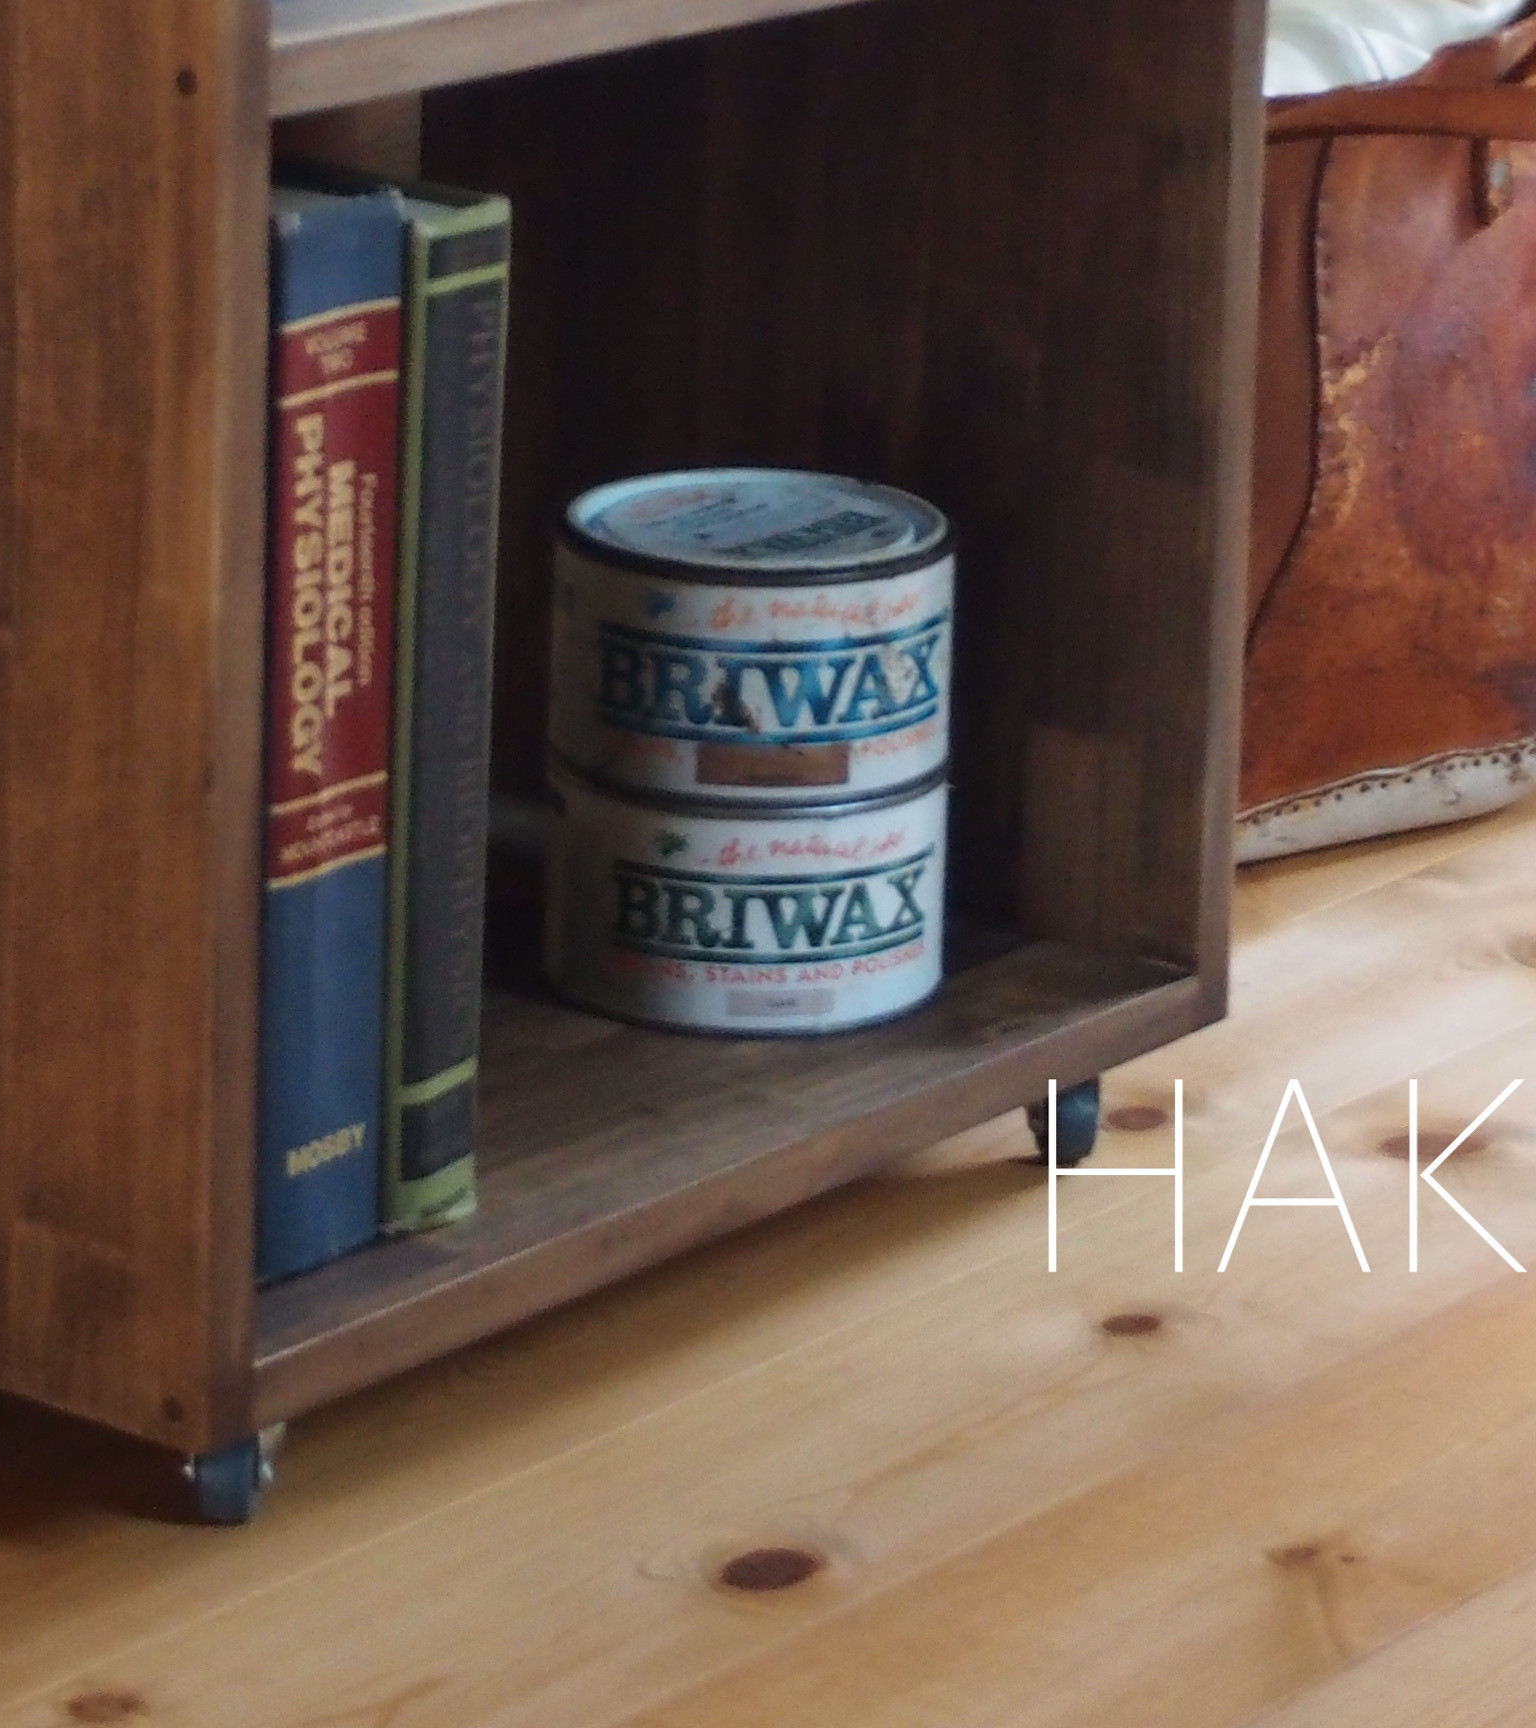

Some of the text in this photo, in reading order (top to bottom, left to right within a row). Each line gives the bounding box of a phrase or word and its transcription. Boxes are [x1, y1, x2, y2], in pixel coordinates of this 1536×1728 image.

[289, 412, 325, 776] PHYSIOLOGY
[324, 459, 357, 720] MEDICAL
[356, 605, 376, 688] edition
[599, 635, 940, 729] BRIWAX
[614, 862, 927, 950] BRIWAX
[704, 964, 788, 985] STAINS
[797, 962, 845, 984] AND
